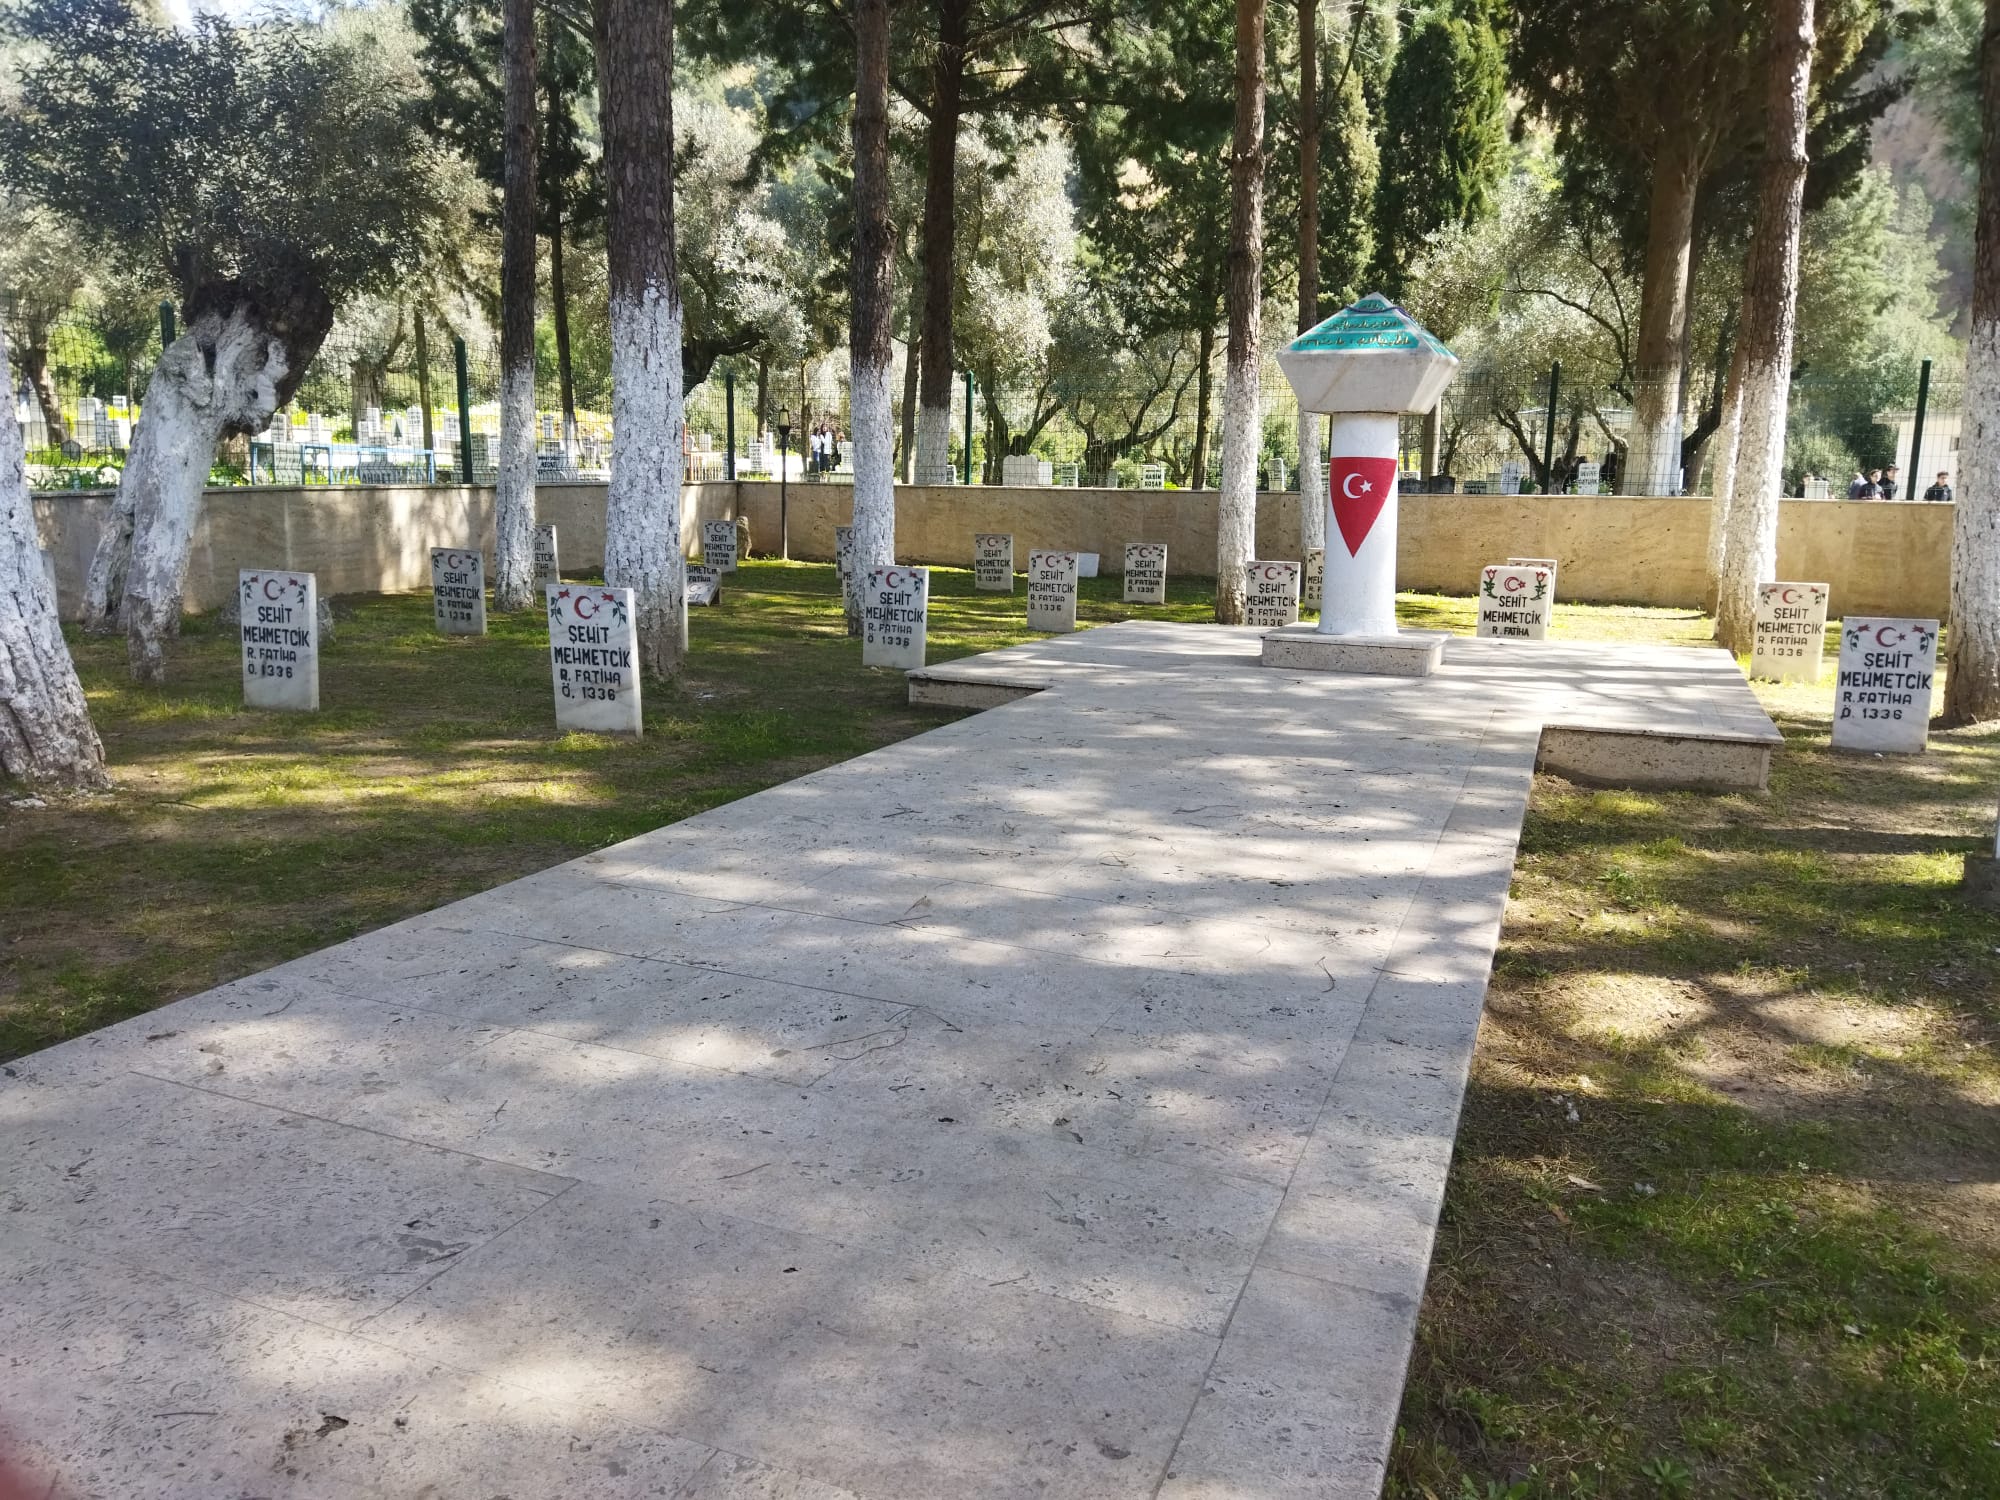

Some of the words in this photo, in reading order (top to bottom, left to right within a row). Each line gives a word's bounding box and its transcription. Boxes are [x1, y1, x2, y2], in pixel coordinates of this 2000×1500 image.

[1483, 610, 1542, 625] MEHMETCİK
[568, 623, 610, 645] ŞEHİT
[1504, 626, 1530, 637] FATİHA
[1757, 621, 1824, 635] MEHMETCİK
[243, 625, 310, 648] MEHMETCİK
[1770, 635, 1808, 646] FATİHA
[259, 646, 297, 663] FATİHA
[554, 645, 631, 669] MEHMETCİK
[1773, 647, 1804, 657] 1336
[1864, 651, 1914, 670] ŞEHİT
[575, 668, 621, 686] FATİHA
[1840, 671, 1932, 690] MEHMETCİK
[582, 686, 617, 701] 1336
[1858, 691, 1912, 705] FATİHA
[1862, 707, 1904, 720] 1336
